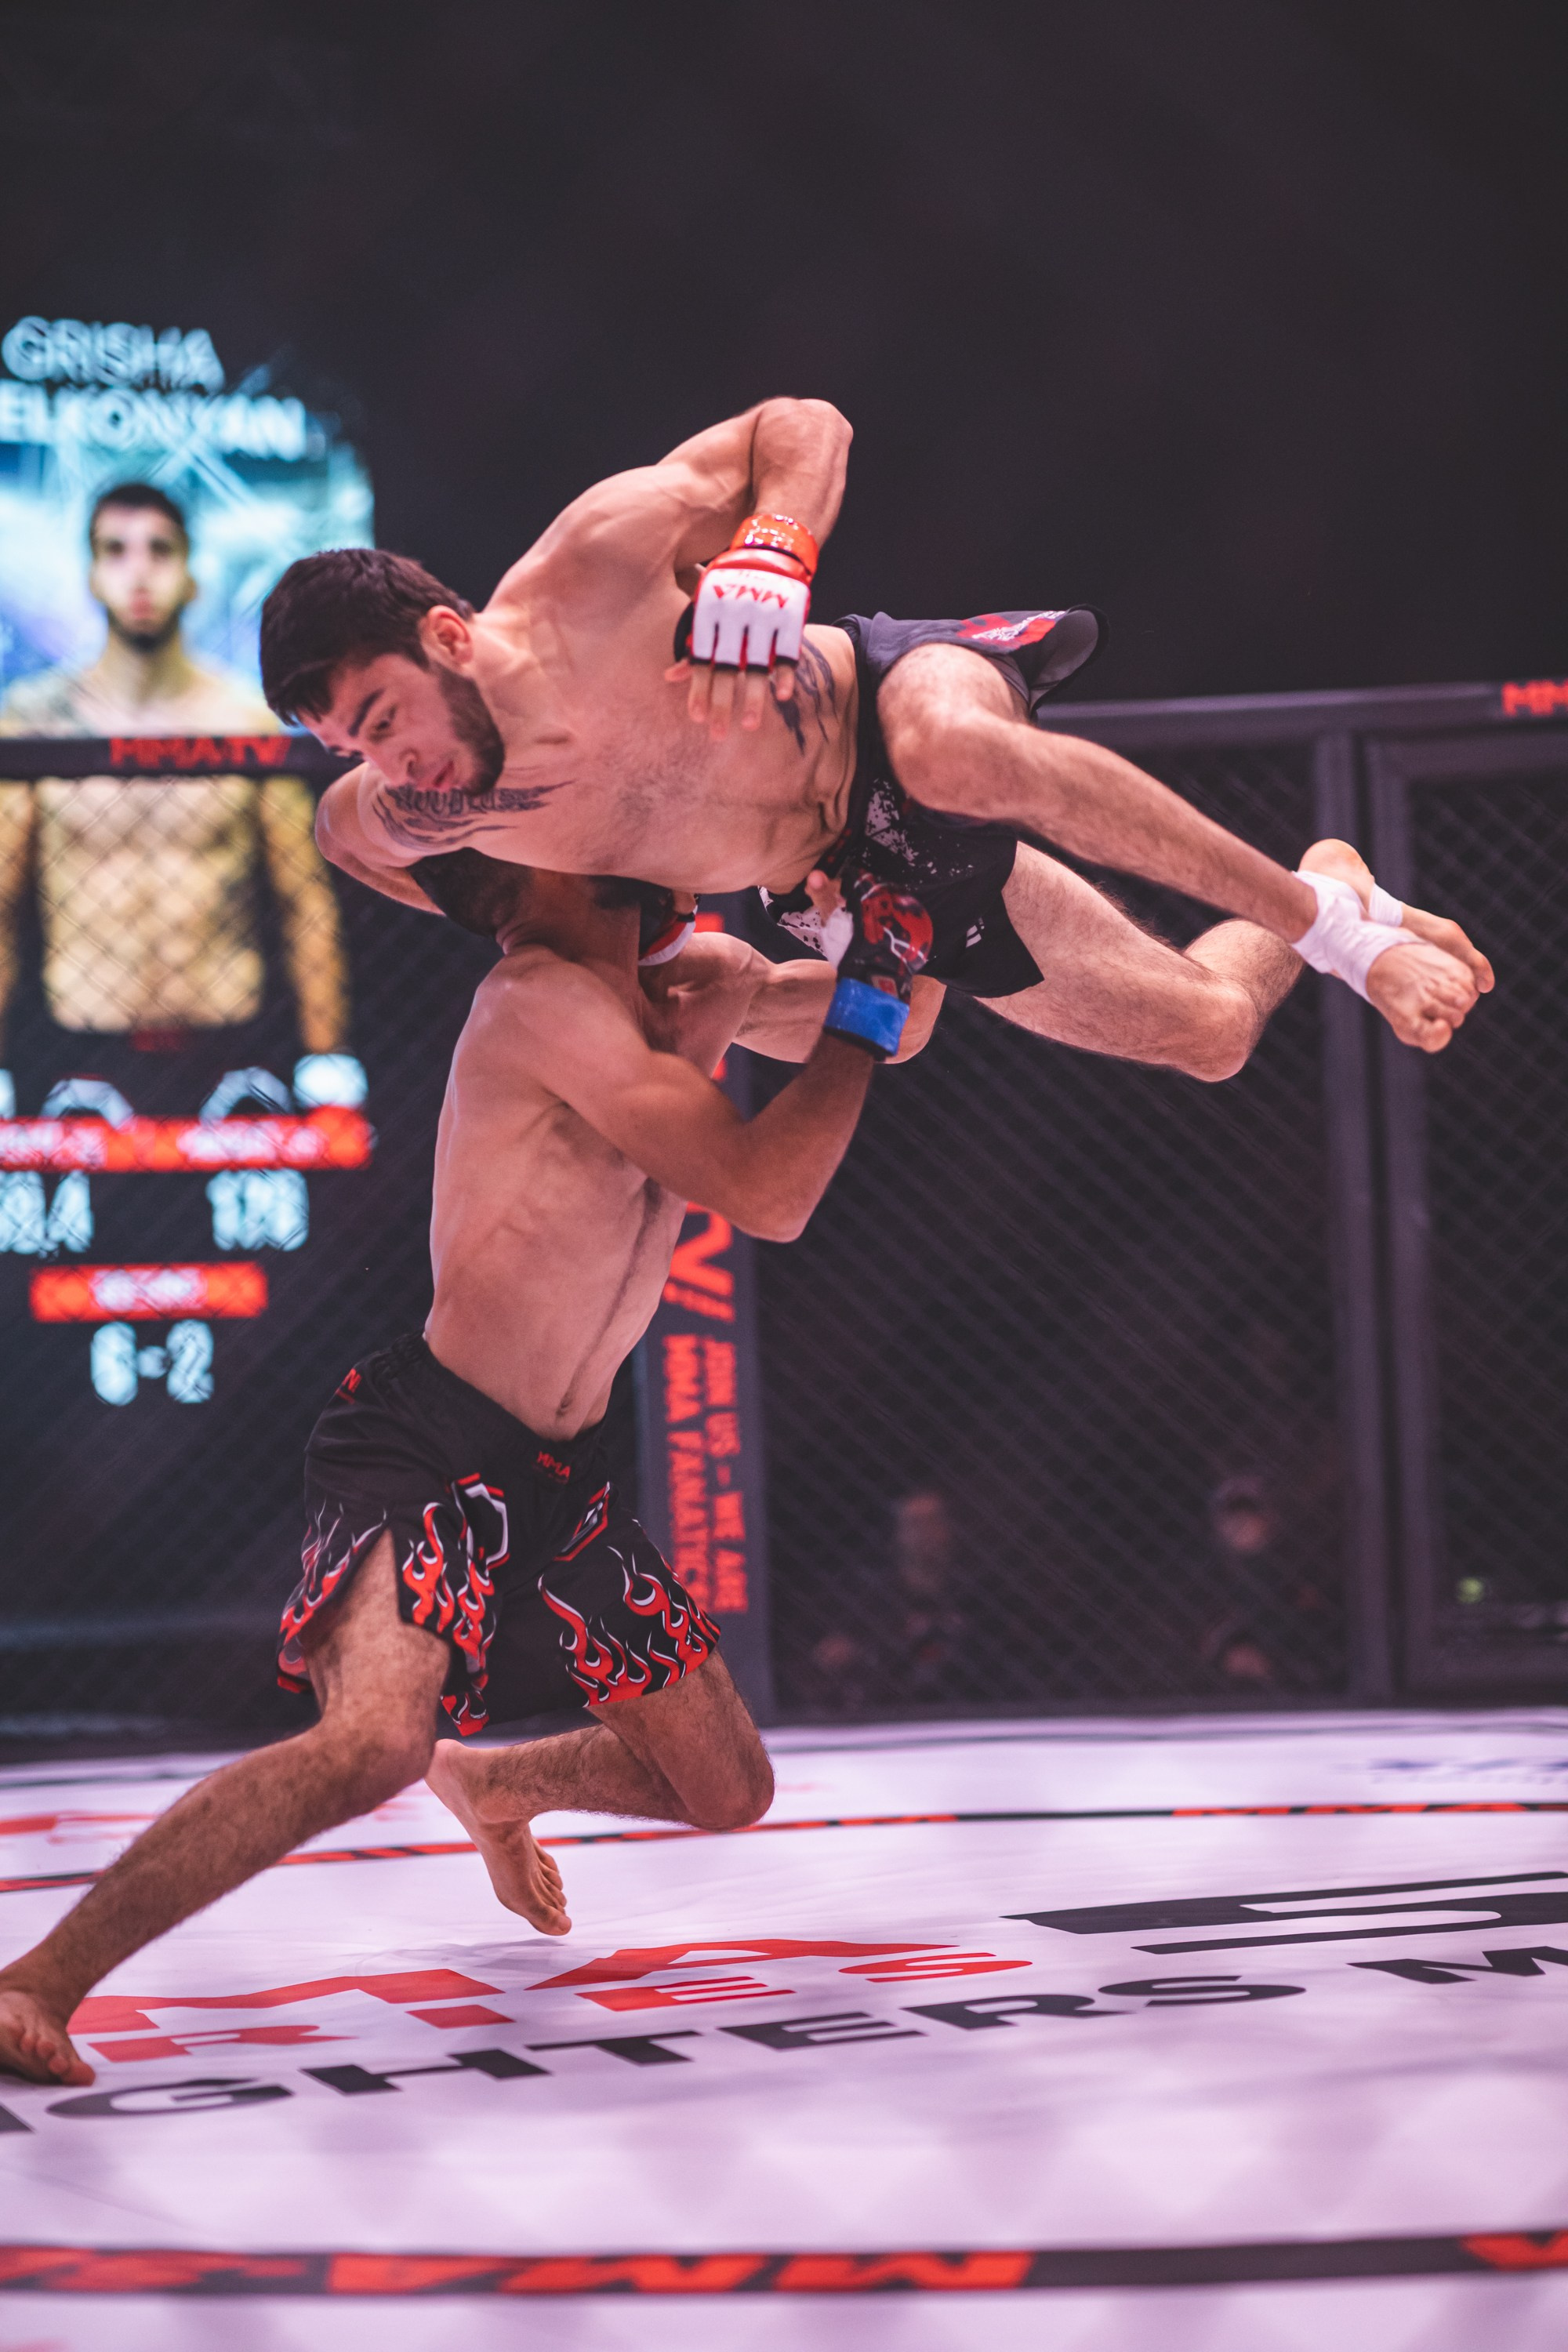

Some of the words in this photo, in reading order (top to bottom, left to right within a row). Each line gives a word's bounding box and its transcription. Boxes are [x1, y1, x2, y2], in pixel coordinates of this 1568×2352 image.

[713, 584, 789, 610] MMA
[663, 1334, 700, 1423] MMA
[67, 1939, 961, 2035] MA
